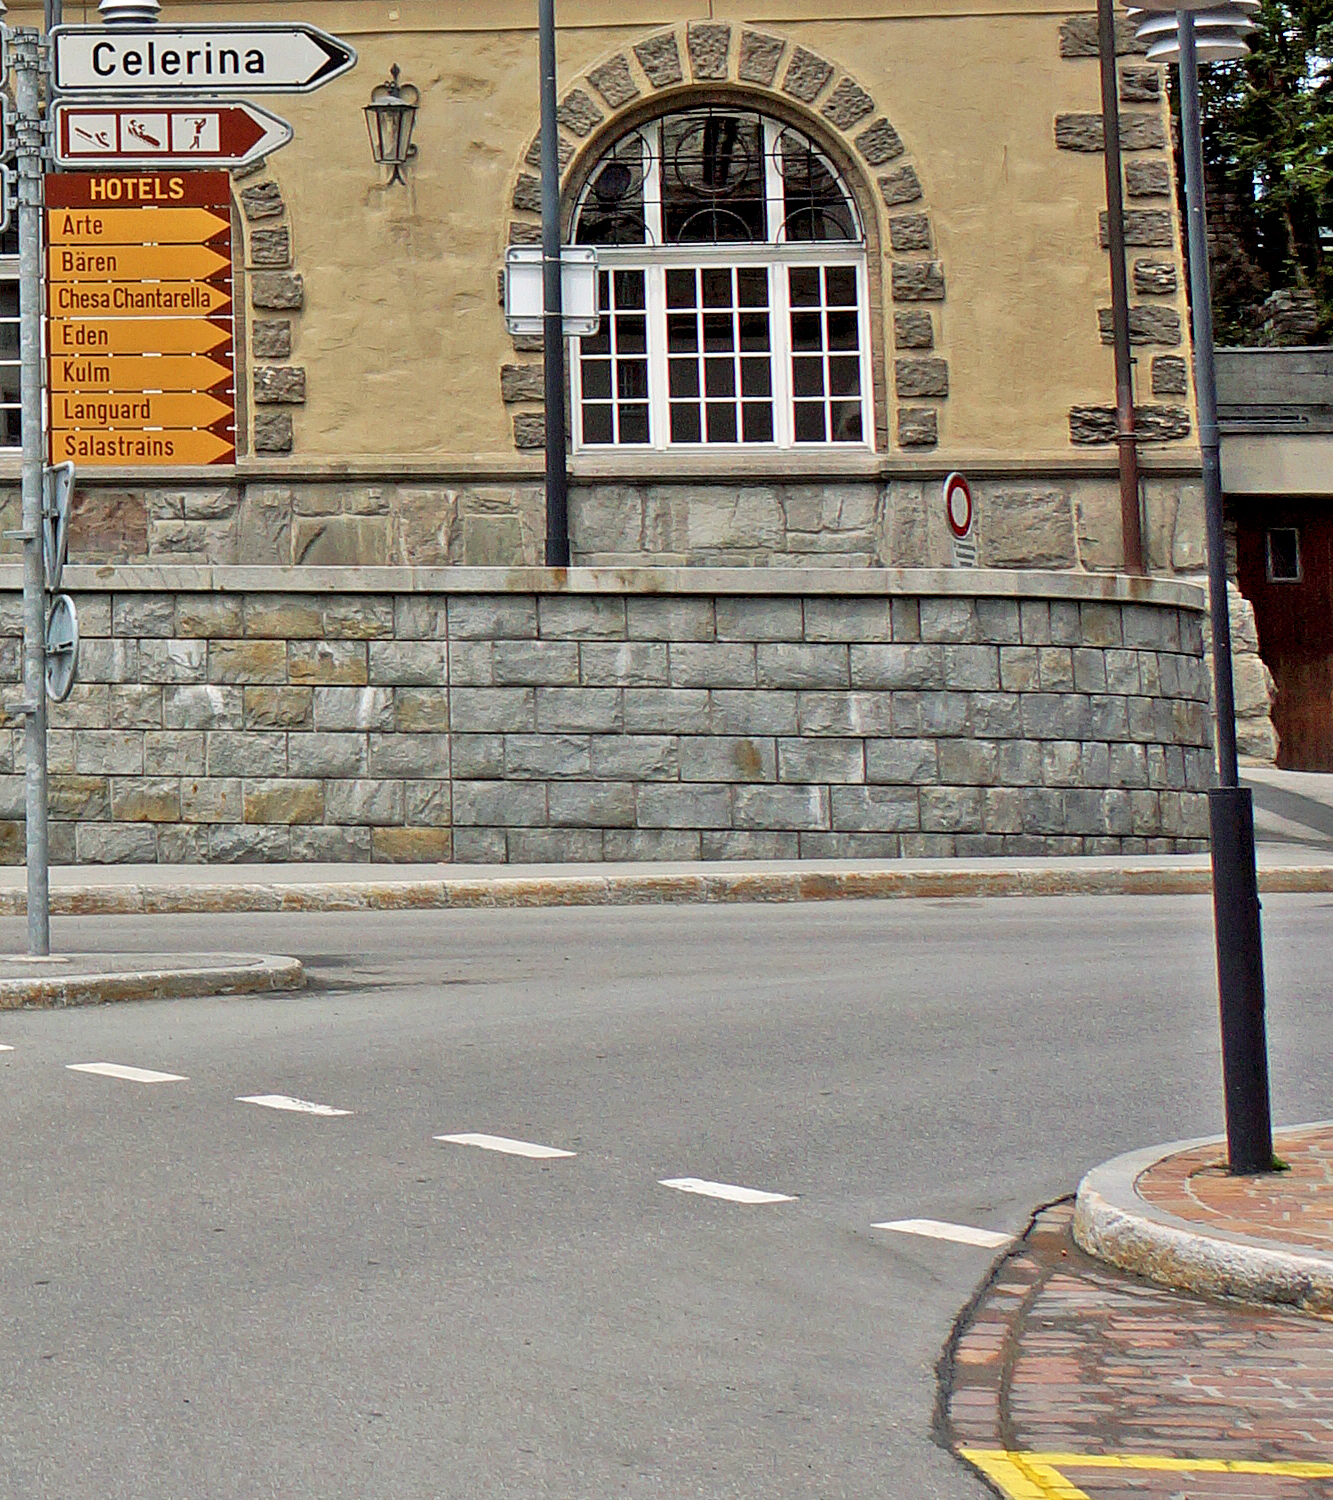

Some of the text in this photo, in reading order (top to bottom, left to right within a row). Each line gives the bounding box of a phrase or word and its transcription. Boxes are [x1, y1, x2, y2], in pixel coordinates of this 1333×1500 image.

[92, 42, 265, 76] Celerina
[90, 177, 184, 200] HOTELS
[62, 215, 103, 236] Arte
[61, 251, 117, 272] Bären
[58, 286, 211, 309] Chesa Chantarella
[62, 324, 109, 346] Eden
[63, 361, 111, 383] Kulm
[64, 398, 151, 425] Languard
[65, 435, 175, 457] Salastrains
